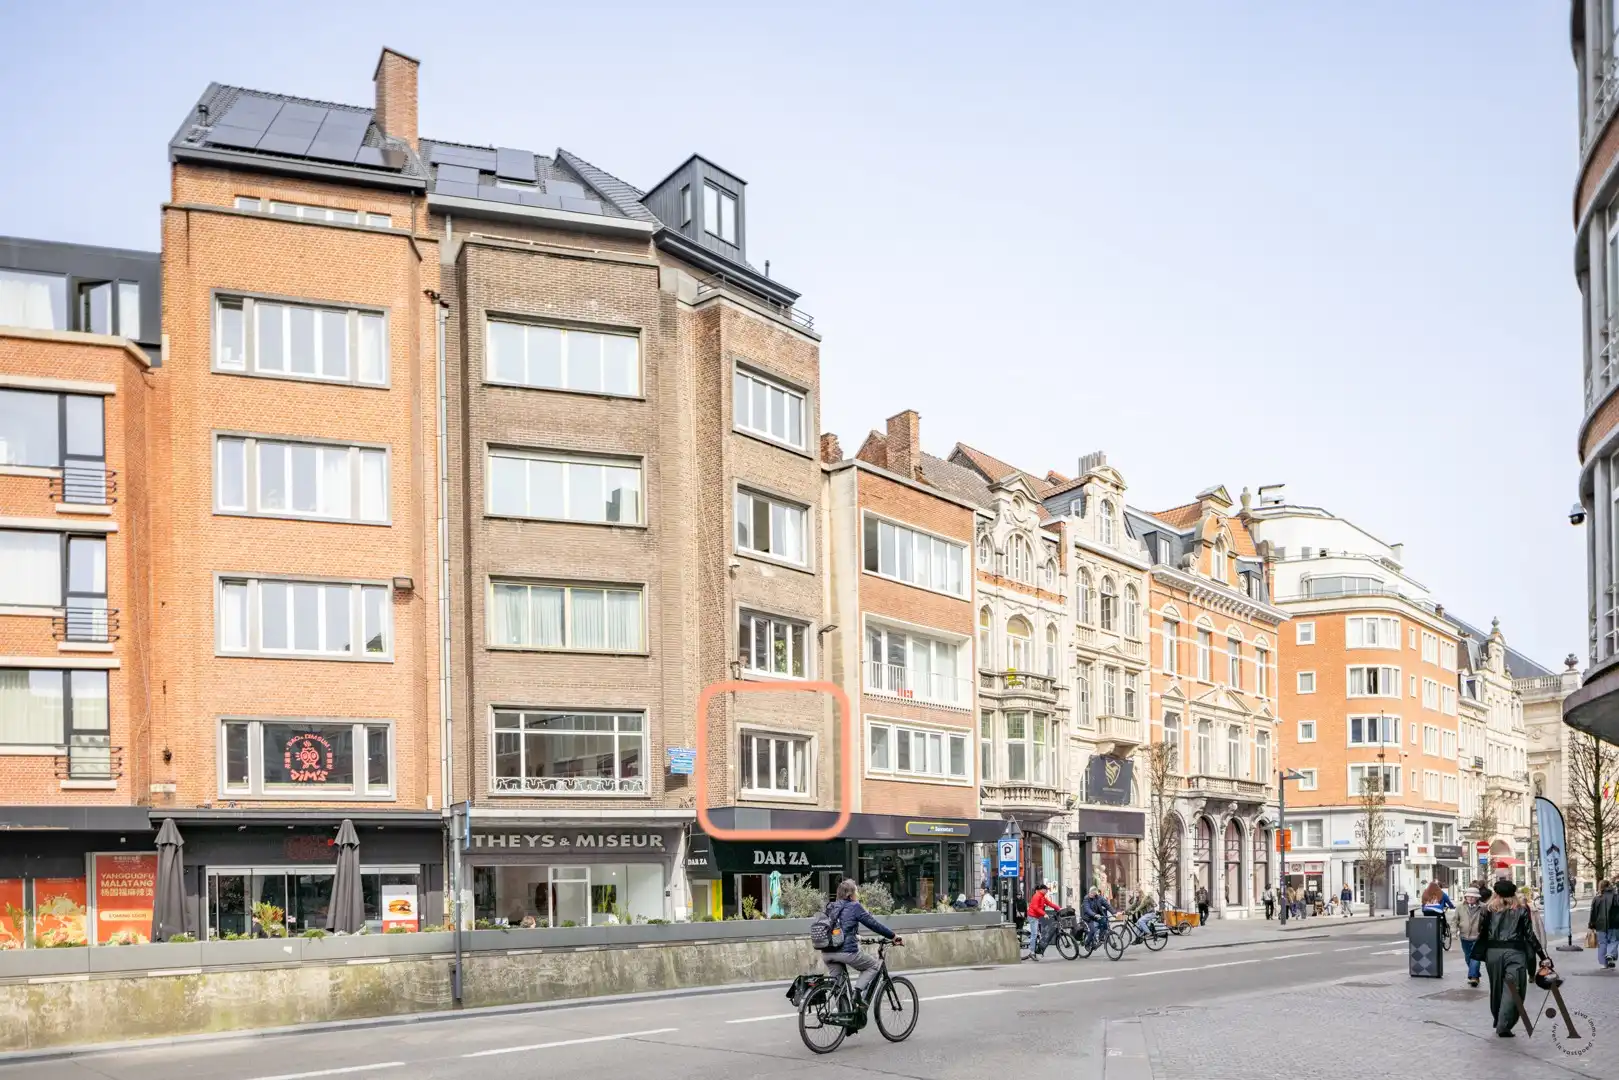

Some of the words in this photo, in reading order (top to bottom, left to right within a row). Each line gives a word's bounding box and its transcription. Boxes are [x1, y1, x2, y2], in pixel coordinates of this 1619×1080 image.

[472, 834, 556, 848] THEYS
[559, 837, 571, 846] &
[575, 834, 664, 848] MISEUR
[687, 858, 700, 866] DAR
[753, 850, 787, 865] DAR
[789, 851, 810, 866] ZA
[101, 872, 155, 880] YANGGUOFU
